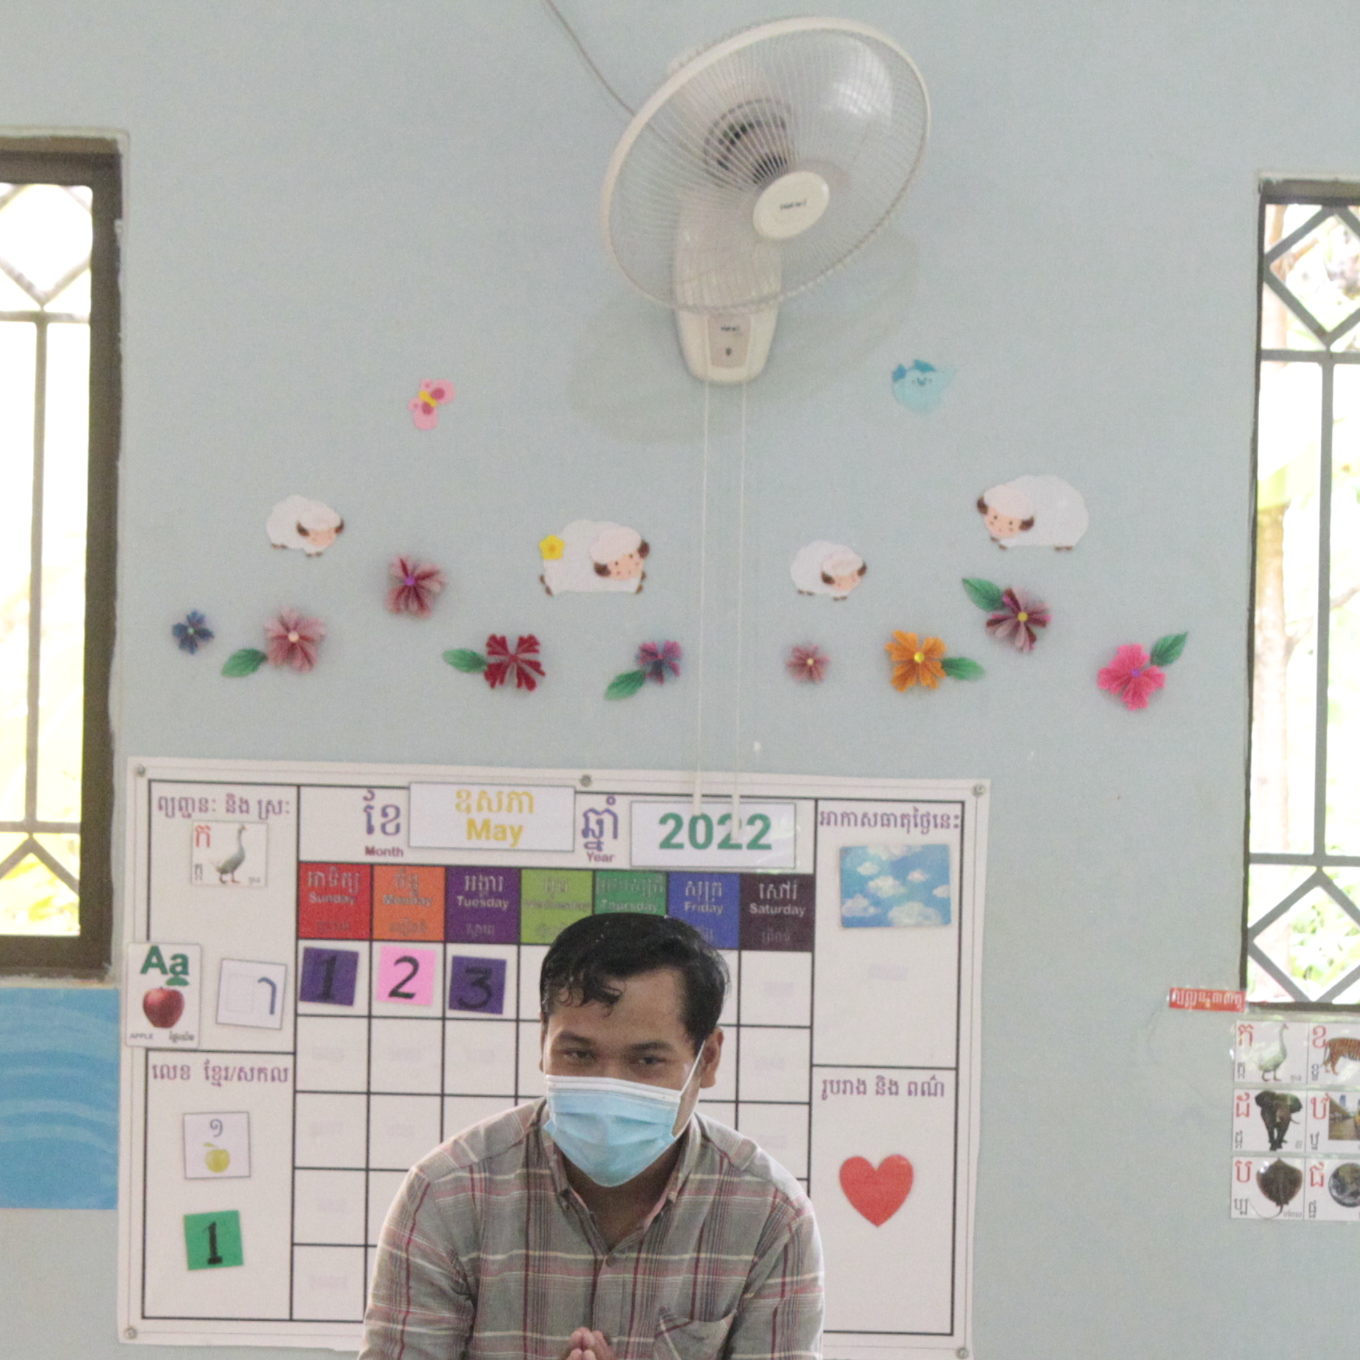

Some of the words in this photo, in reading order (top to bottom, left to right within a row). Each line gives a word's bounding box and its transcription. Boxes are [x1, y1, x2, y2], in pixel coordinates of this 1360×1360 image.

[225, 793, 250, 815] និង
[455, 789, 535, 814] ឧសភា
[466, 817, 524, 847] May
[581, 795, 619, 852] ឆ្នាំ
[658, 812, 773, 851] 2022
[819, 805, 960, 835] អាកាសធាតុថ្ងៃនេះ
[194, 824, 212, 848] ក
[363, 845, 404, 859] Month
[586, 851, 616, 864] Year
[309, 892, 357, 906] Sunday
[383, 894, 432, 907] Monday
[457, 895, 510, 911] Tuesday
[684, 900, 724, 915] Friday
[749, 901, 807, 918] Saturday
[140, 945, 190, 976] Aa
[317, 955, 338, 1001] 1
[388, 955, 420, 999] 2
[457, 966, 493, 1010] 3
[1237, 1024, 1255, 1046] ក
[1312, 1025, 1328, 1049] ខ
[152, 1063, 191, 1081] លេខ
[821, 1077, 867, 1101] រូបរាង
[875, 1074, 900, 1097] និង
[1234, 1160, 1253, 1183] ប
[203, 1220, 223, 1266] 1
